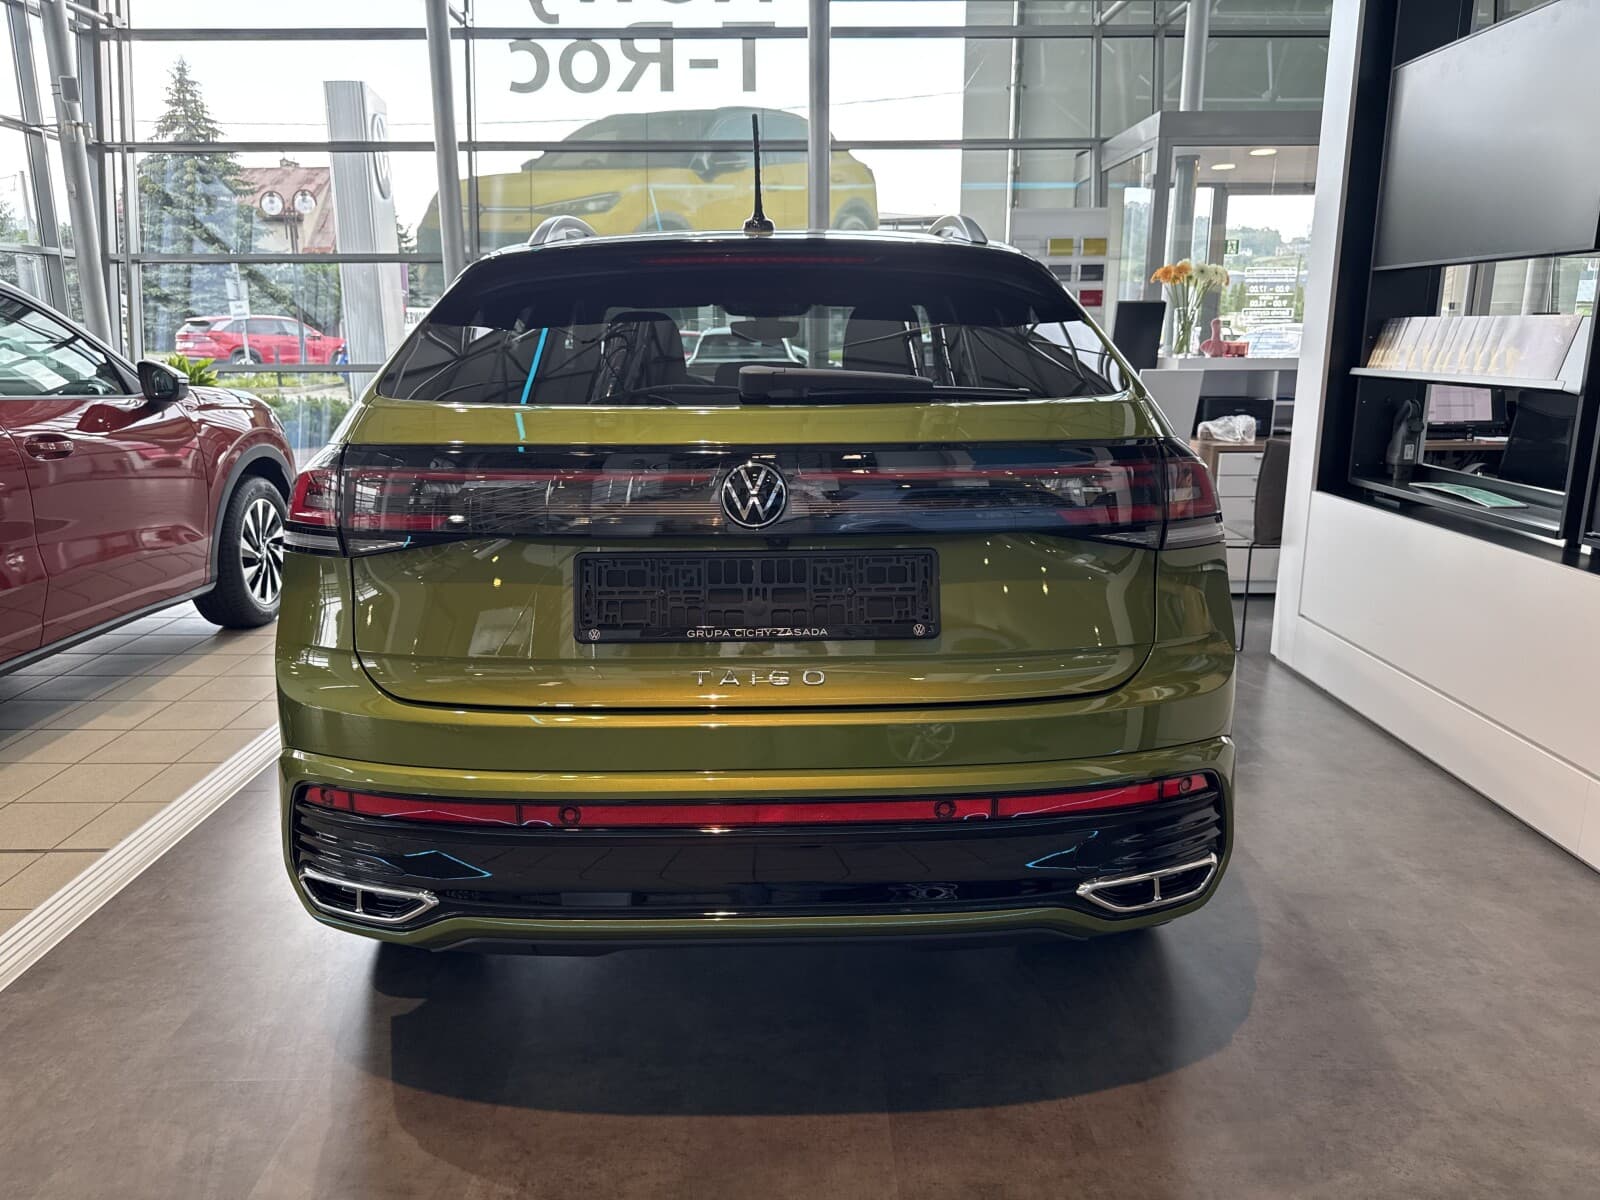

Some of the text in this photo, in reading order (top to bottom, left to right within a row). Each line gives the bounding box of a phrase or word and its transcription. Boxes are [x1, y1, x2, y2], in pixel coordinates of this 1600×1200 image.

[686, 627, 829, 639] GRUPA CICHY-ZASADA
[690, 669, 826, 686] TAIGO
